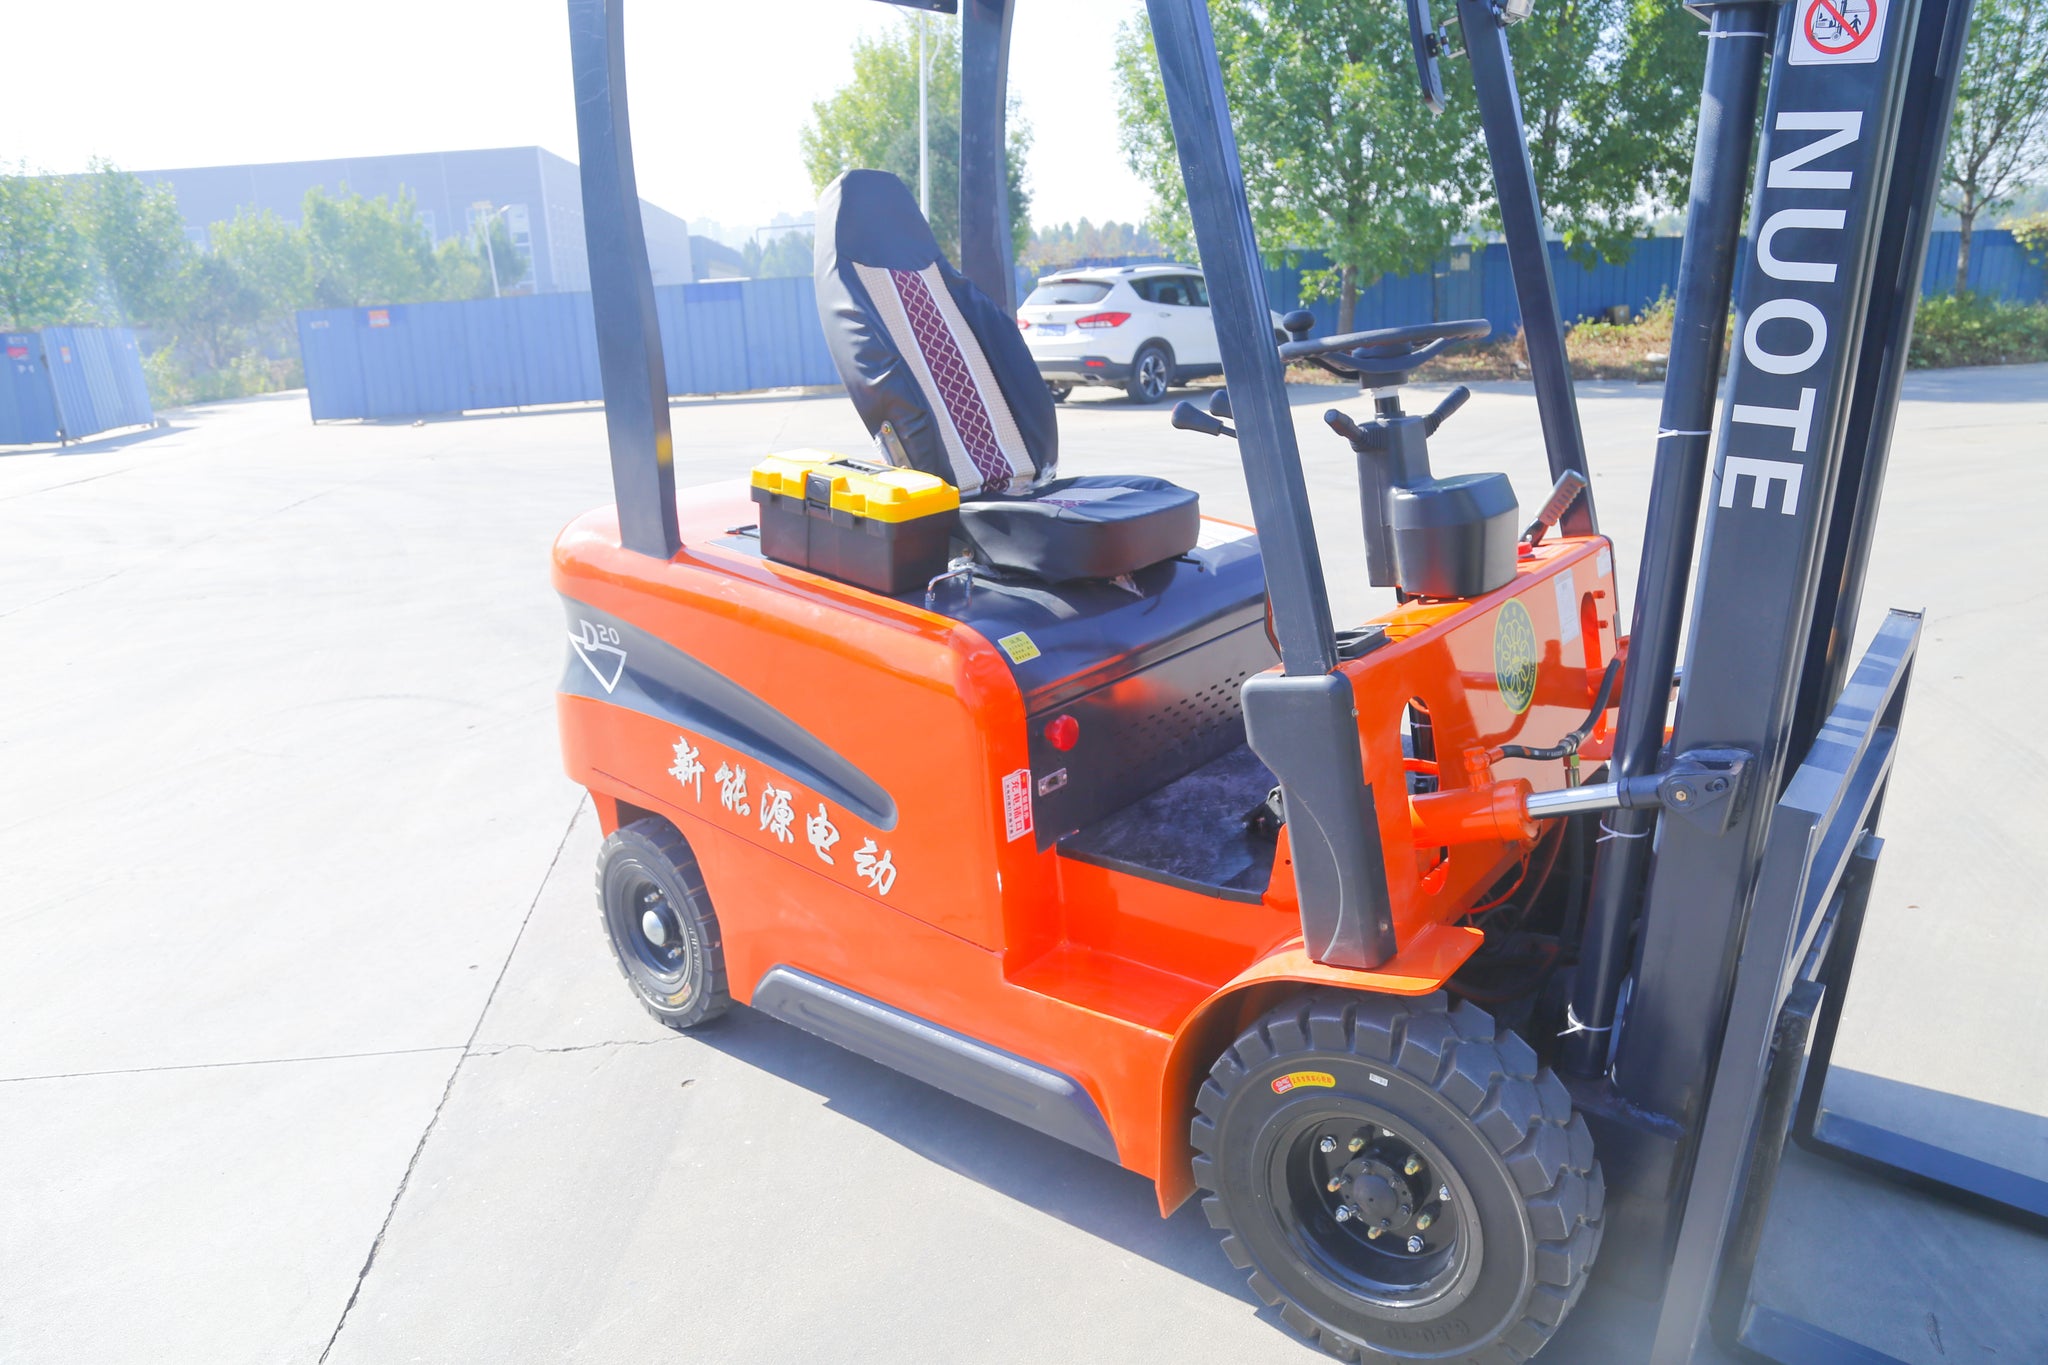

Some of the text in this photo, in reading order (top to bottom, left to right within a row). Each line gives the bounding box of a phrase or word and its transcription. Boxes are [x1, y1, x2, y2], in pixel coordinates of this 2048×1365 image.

[1718, 110, 1864, 516] NUOTE
[579, 619, 621, 651] D20
[667, 735, 898, 896] 新能源电动
